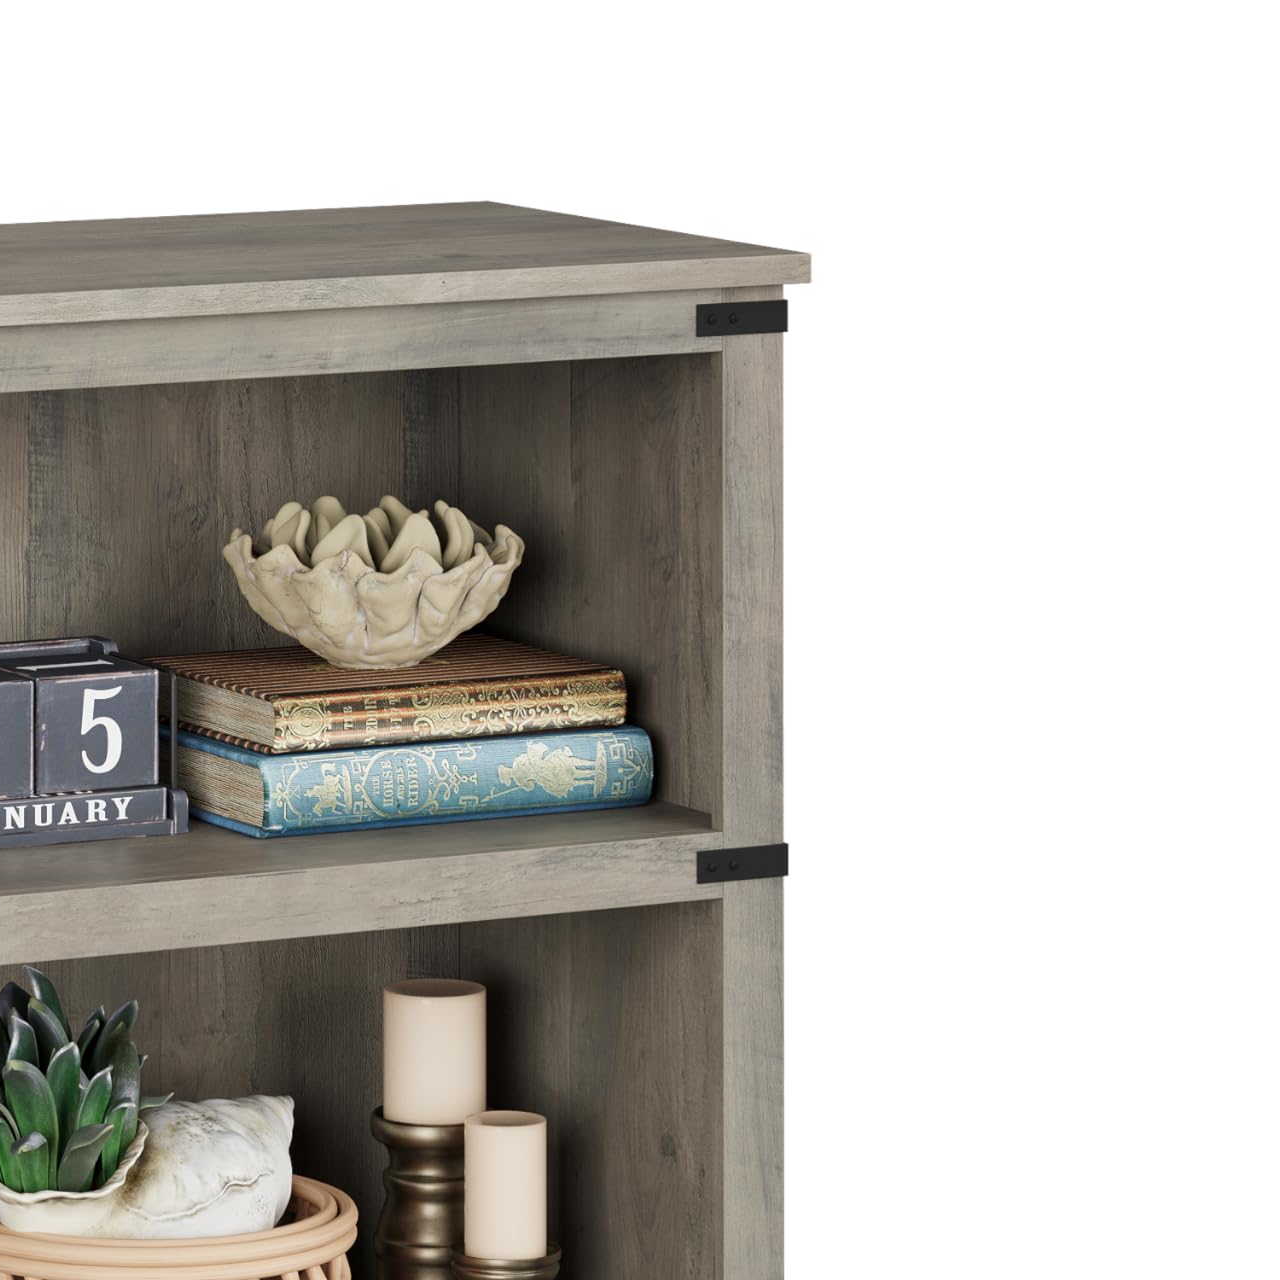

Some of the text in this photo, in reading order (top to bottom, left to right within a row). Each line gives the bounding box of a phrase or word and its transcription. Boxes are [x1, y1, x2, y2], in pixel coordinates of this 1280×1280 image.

[80, 686, 122, 774] 5
[381, 760, 394, 807] HORSE
[407, 756, 419, 807] RIDER
